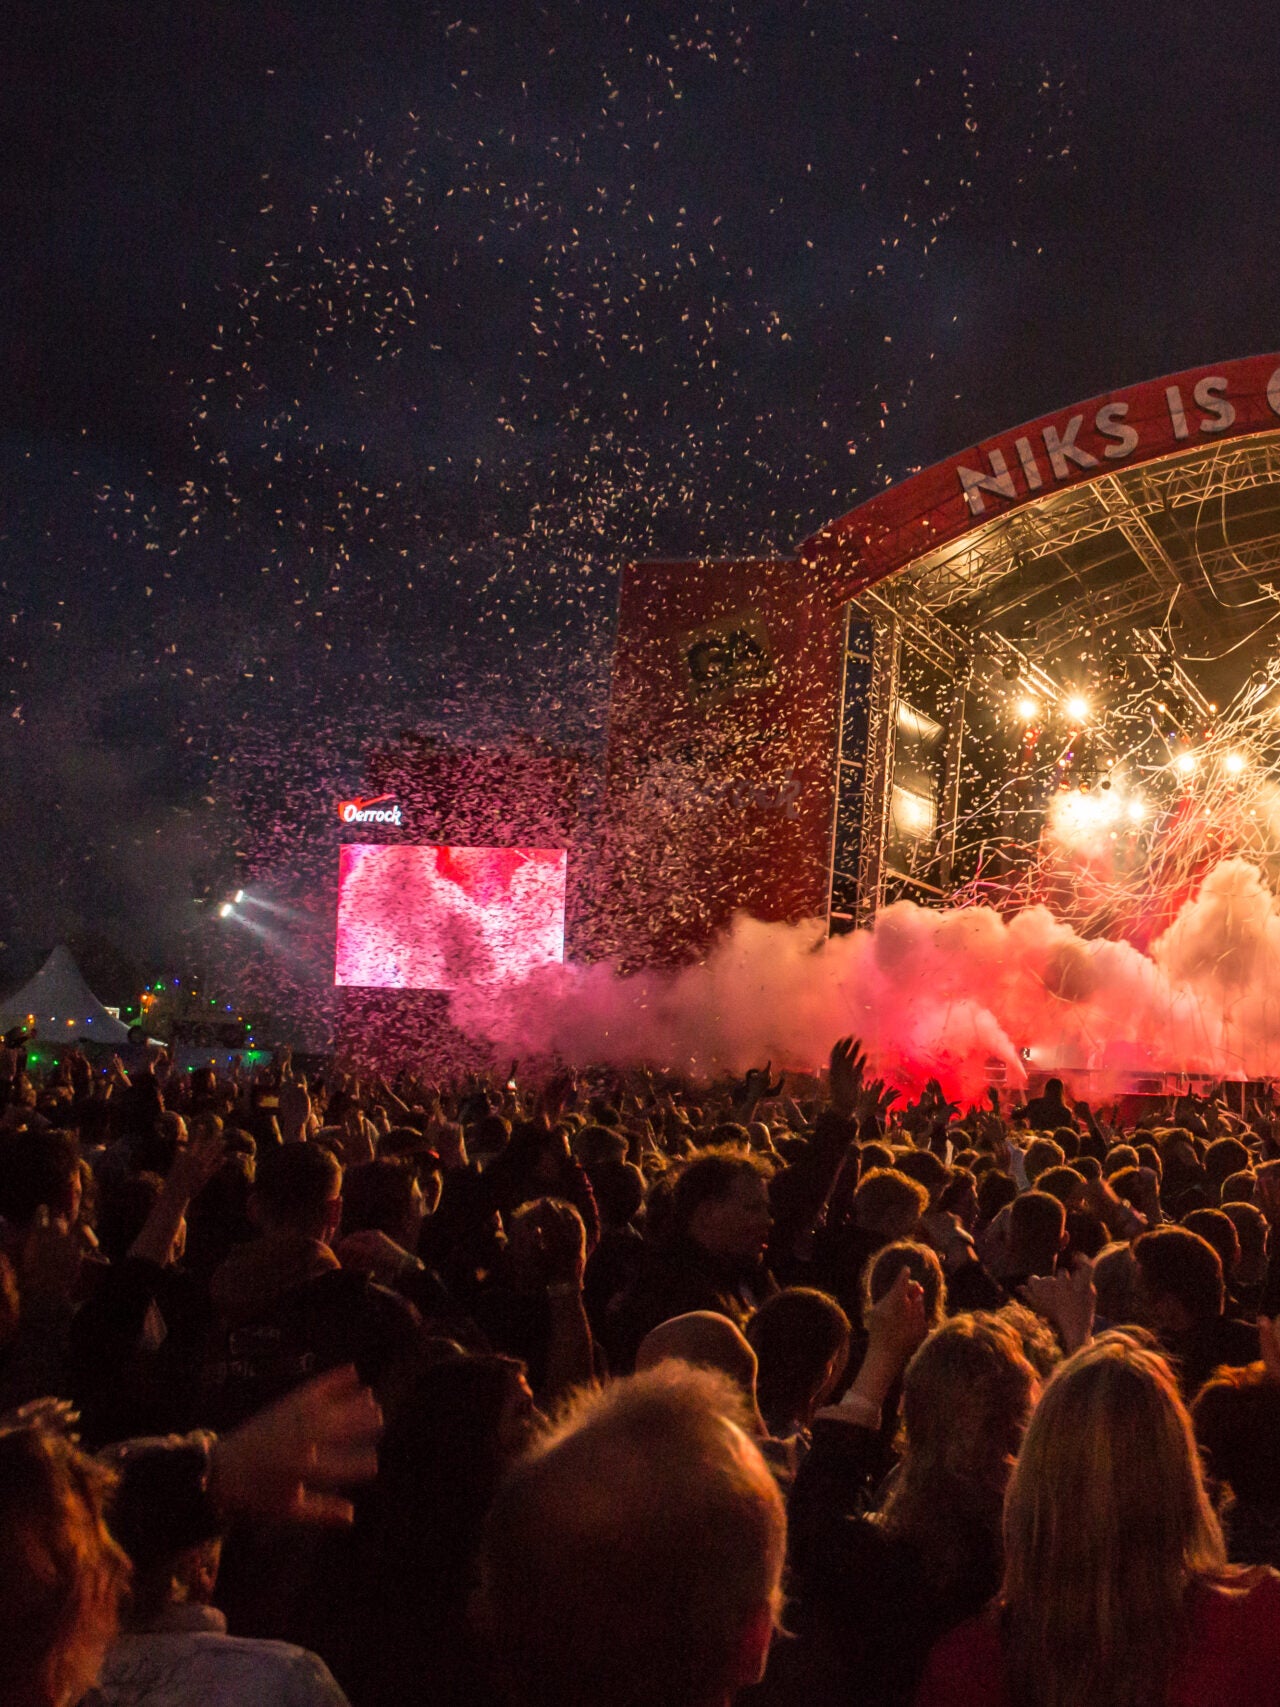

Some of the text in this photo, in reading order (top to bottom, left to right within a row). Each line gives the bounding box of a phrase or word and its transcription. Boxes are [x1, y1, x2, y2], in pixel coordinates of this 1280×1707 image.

[957, 402, 1139, 515] NIKS
[1165, 376, 1236, 440] IS
[343, 804, 402, 825] Oerrock
